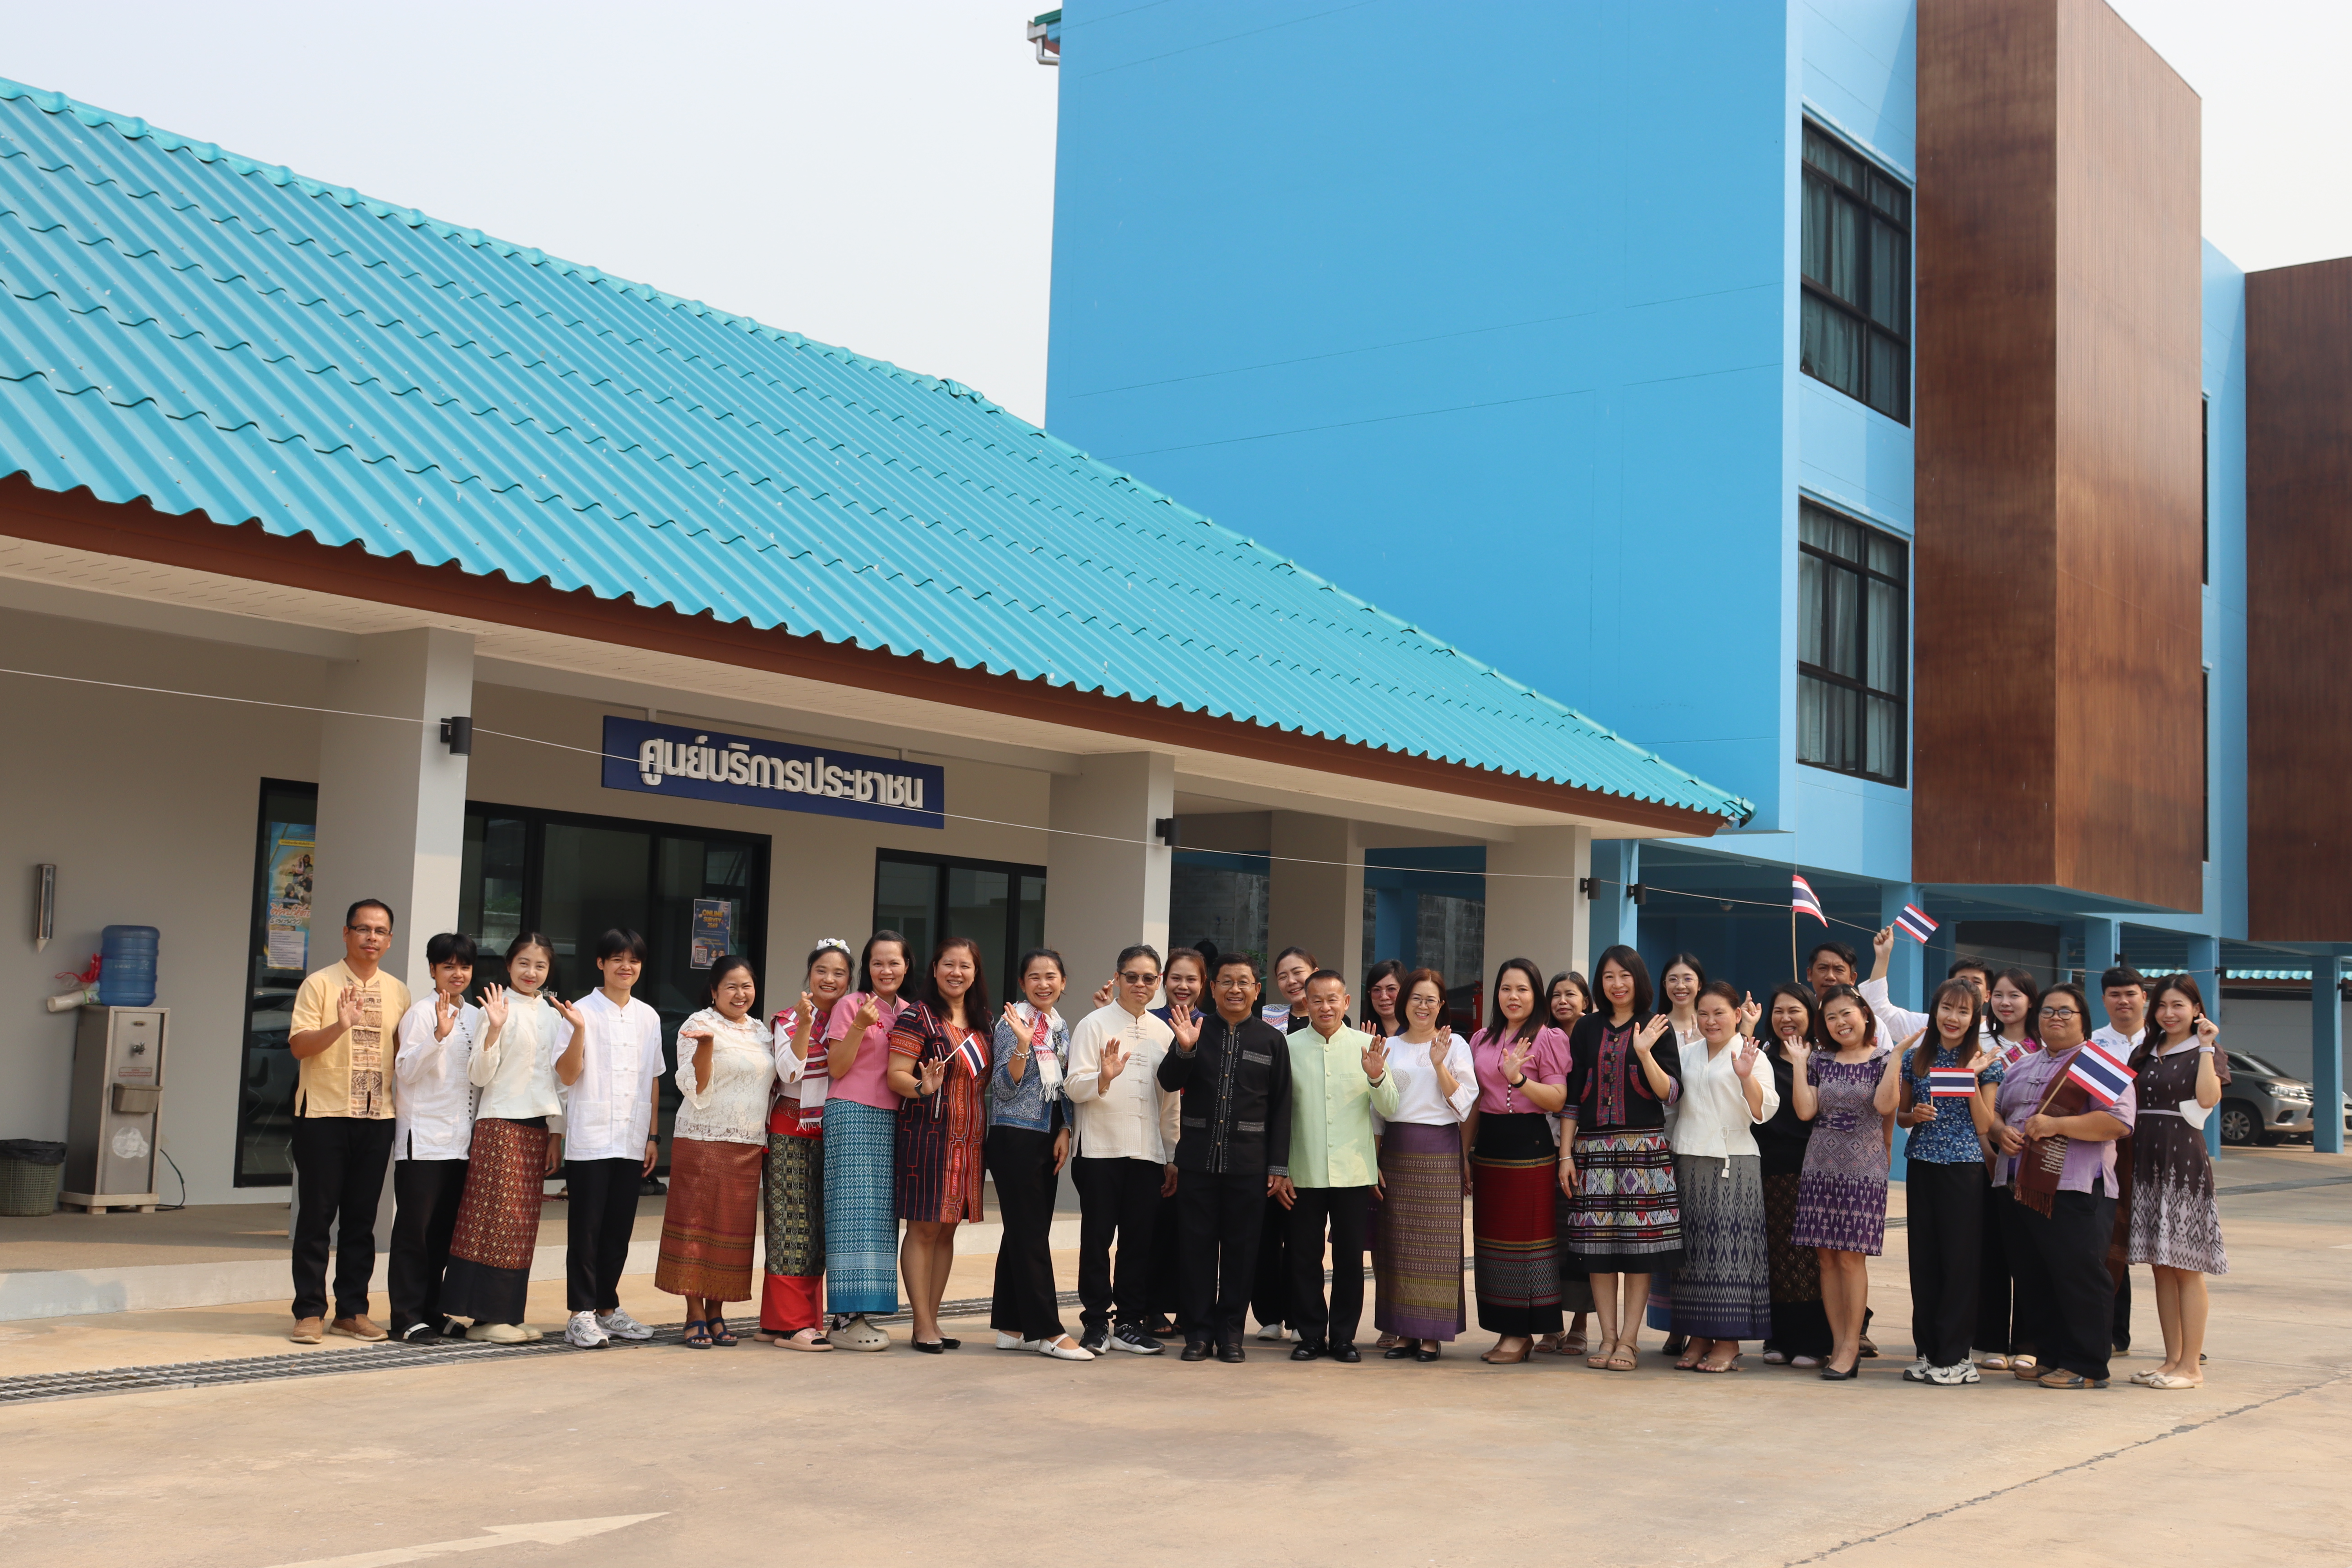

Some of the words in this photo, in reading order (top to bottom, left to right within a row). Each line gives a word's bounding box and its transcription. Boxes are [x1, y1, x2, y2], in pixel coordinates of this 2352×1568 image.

[639, 735, 923, 809] ศูนย์บริการประชาชน
